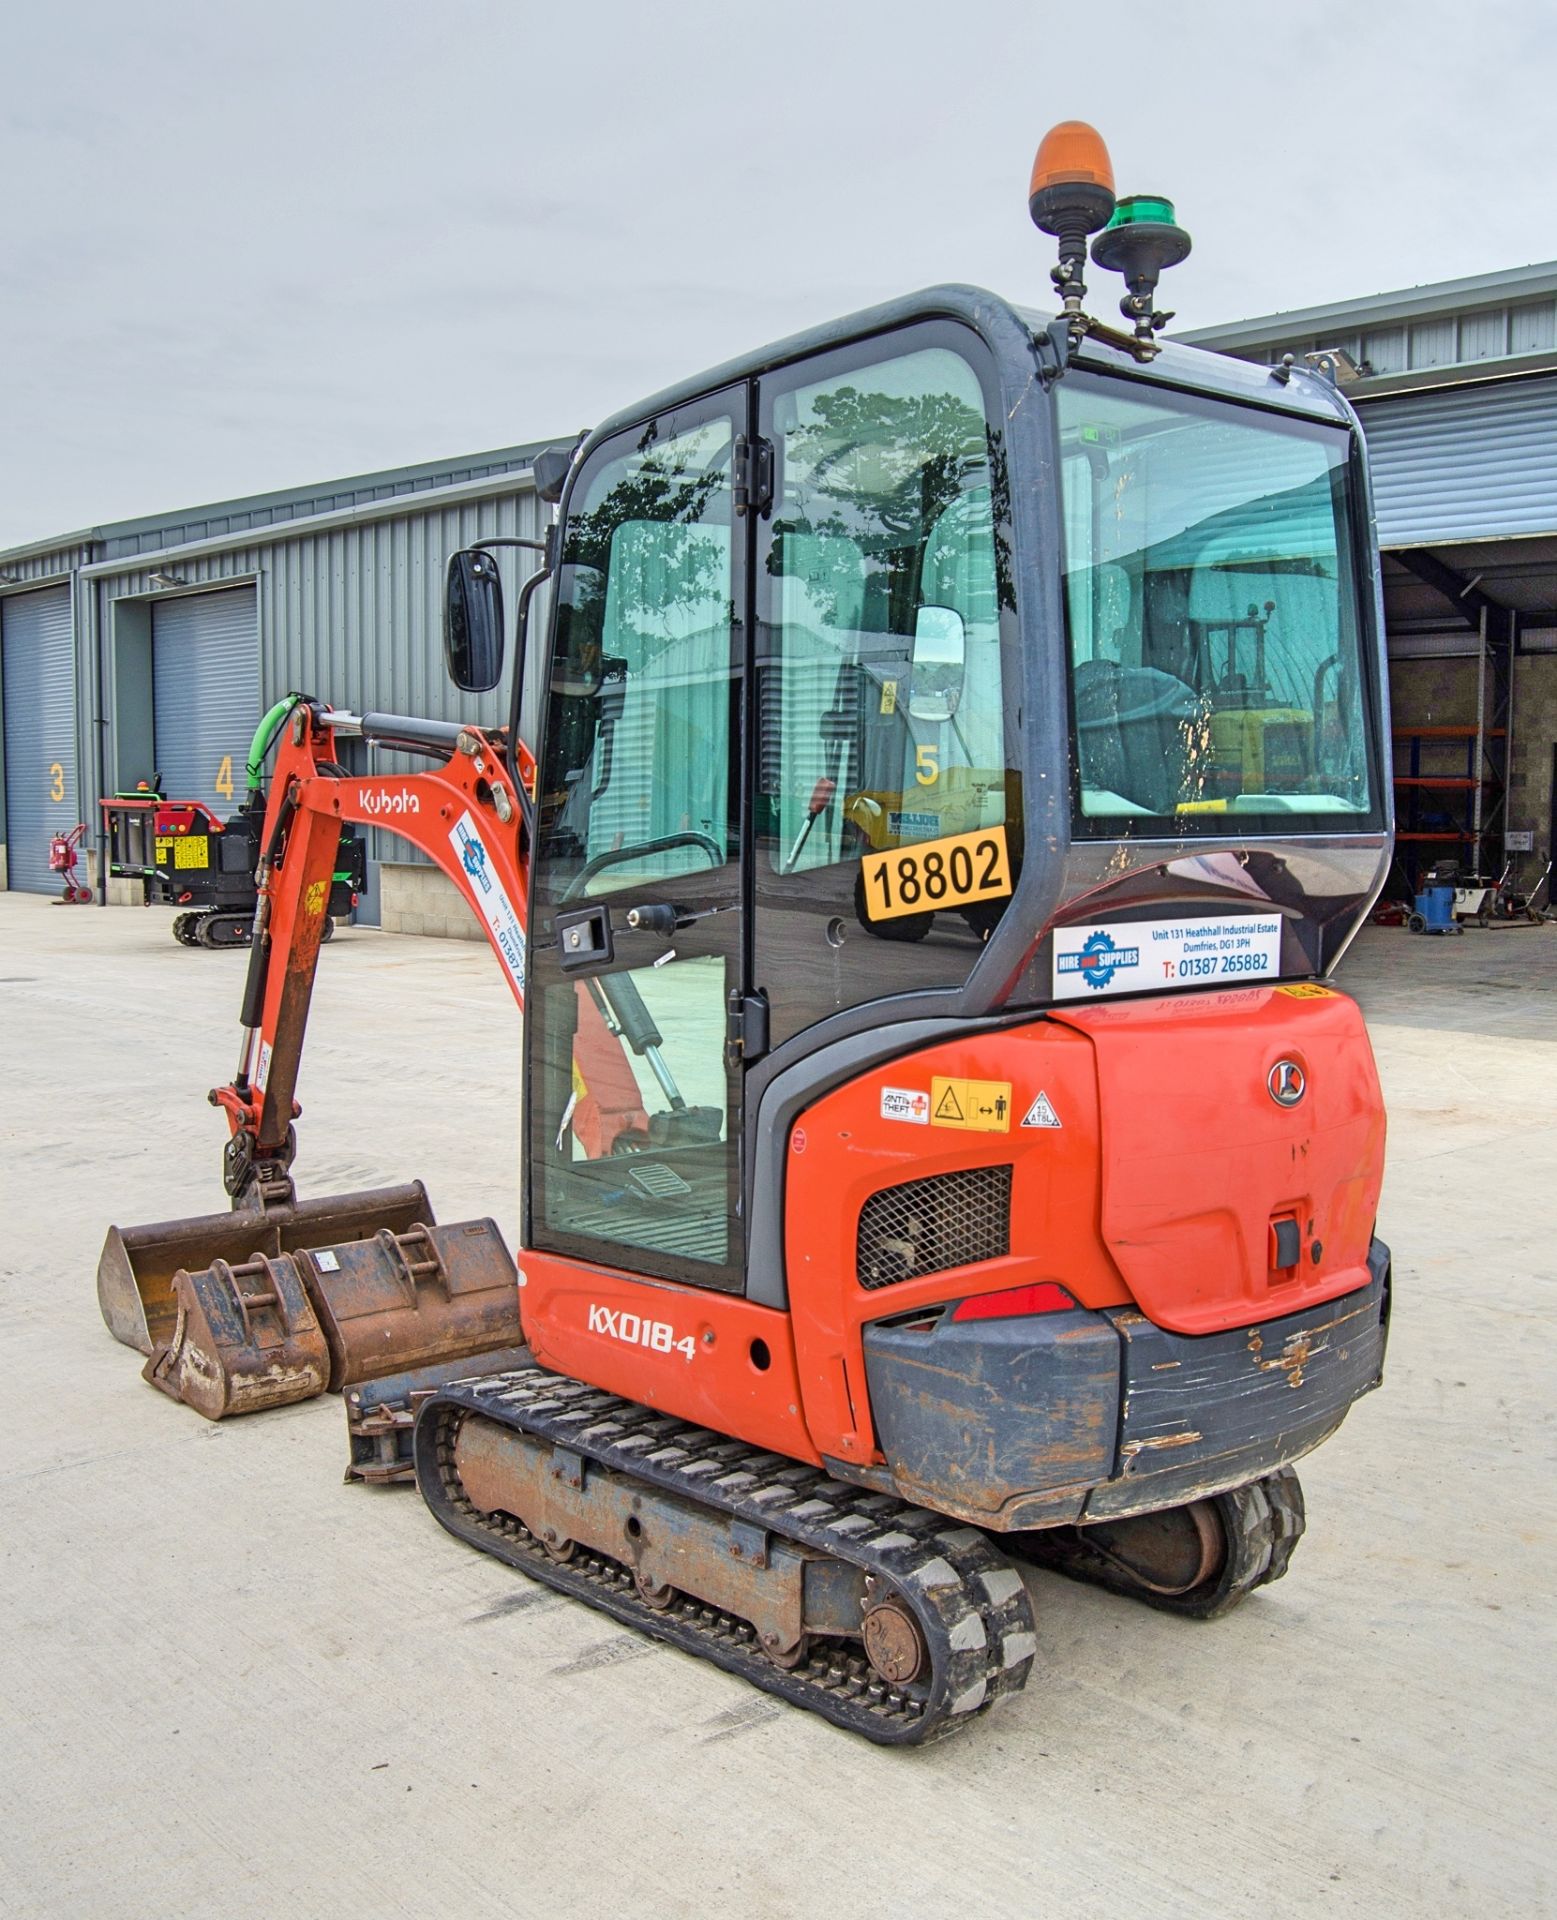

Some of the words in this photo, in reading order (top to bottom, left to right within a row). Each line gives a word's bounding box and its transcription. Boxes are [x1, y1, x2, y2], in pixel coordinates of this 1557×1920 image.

[215, 755, 234, 800] 4
[915, 744, 940, 785] 5
[50, 762, 65, 802] 3
[359, 788, 420, 814] Kubota
[873, 839, 1003, 909] 18802
[1152, 929, 1169, 941] Unit
[1171, 929, 1184, 940] 131
[1185, 925, 1221, 938] Heathhall
[1222, 923, 1256, 935] Industrial
[1257, 923, 1278, 934] Estate
[1183, 941, 1218, 953] Dumfries,
[1220, 939, 1234, 950] DG1
[1236, 938, 1251, 949] 3PH
[499, 931, 520, 969] 01387
[1059, 955, 1080, 970] HIRE
[1098, 950, 1138, 967] SUPPLIES
[1162, 961, 1175, 978] T:
[1179, 957, 1218, 977] 01387
[1221, 953, 1268, 973] 265882
